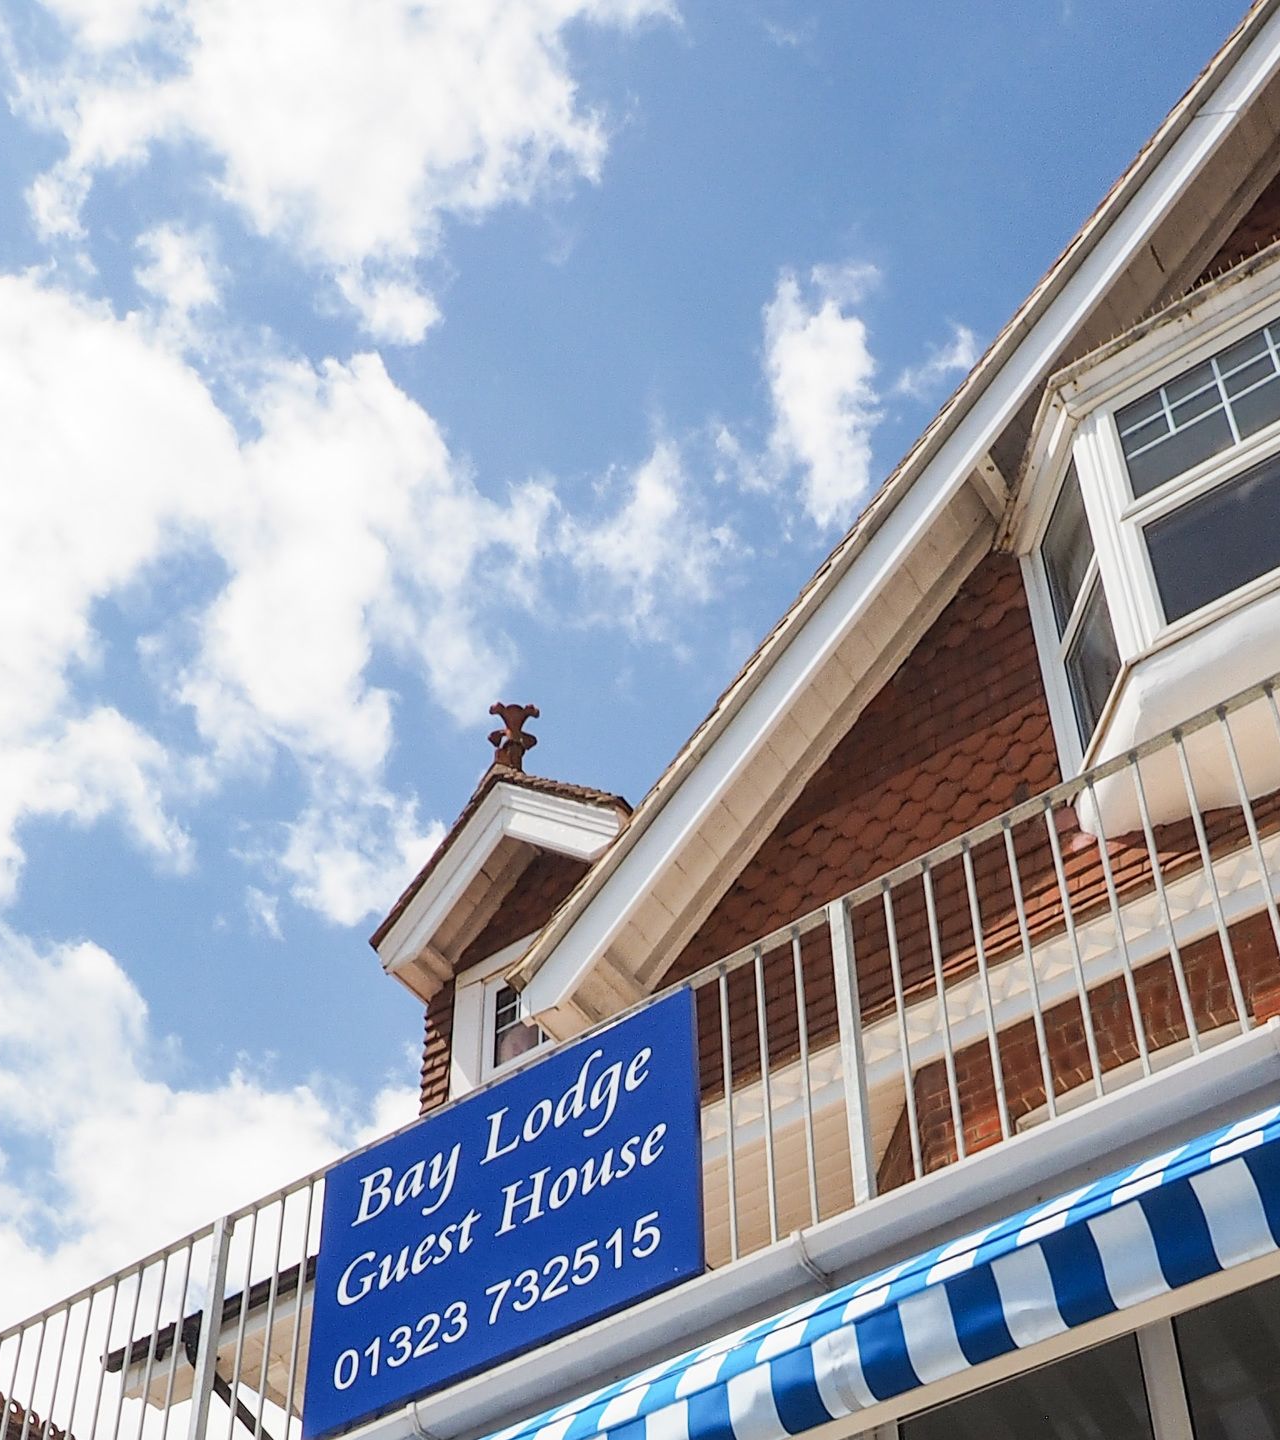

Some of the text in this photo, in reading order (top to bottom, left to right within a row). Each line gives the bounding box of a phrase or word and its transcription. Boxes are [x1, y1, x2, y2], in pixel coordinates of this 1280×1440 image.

[336, 1123, 667, 1306] Guest House
[351, 1047, 652, 1228] Bay Lodge
[333, 1211, 662, 1390] 01323 732515
